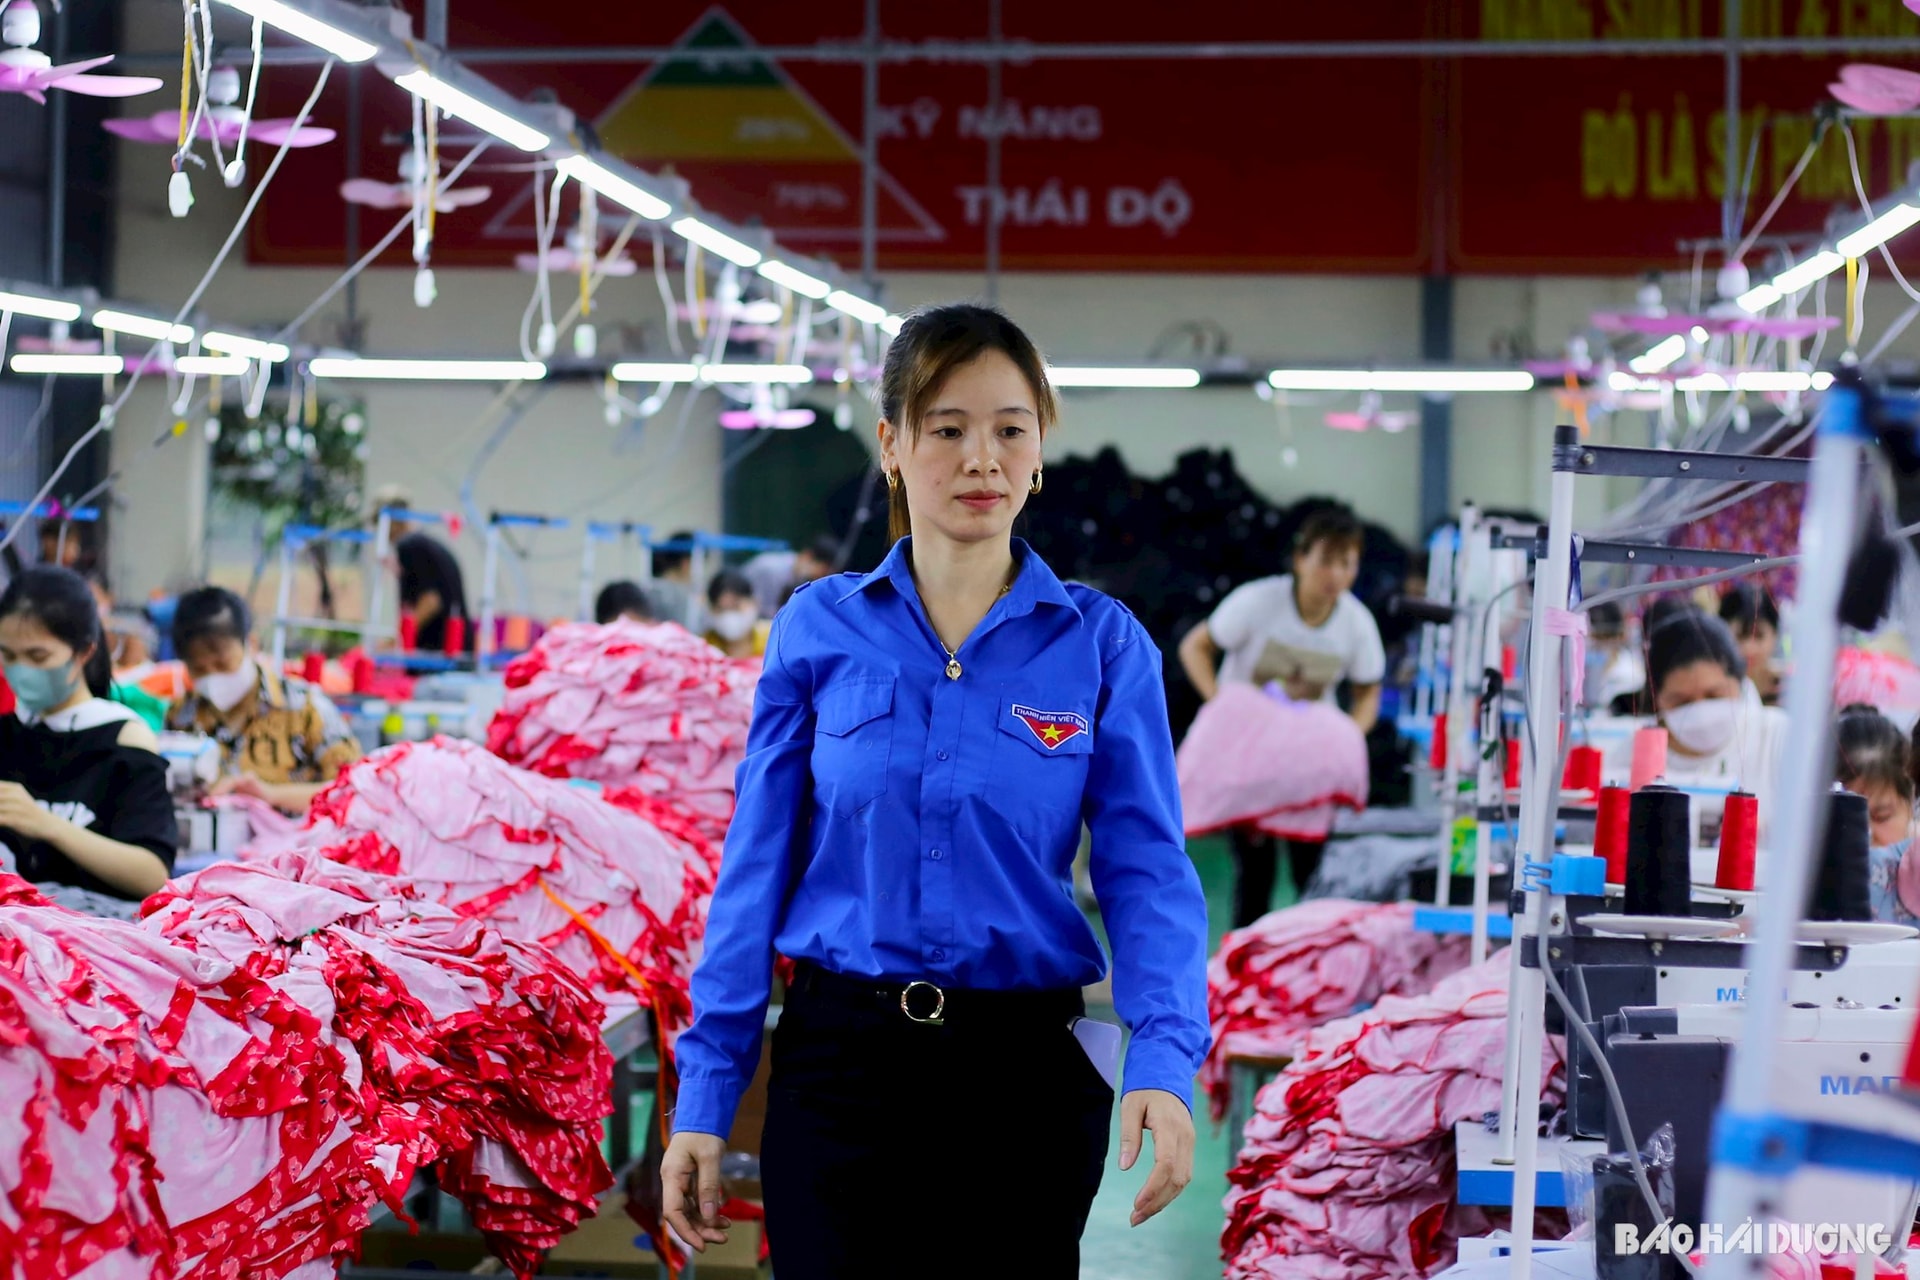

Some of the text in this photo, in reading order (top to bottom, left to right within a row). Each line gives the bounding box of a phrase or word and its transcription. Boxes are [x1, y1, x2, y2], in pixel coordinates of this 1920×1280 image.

[956, 179, 1192, 236] THÁI ĐỘ
[1016, 708, 1039, 720] THANH
